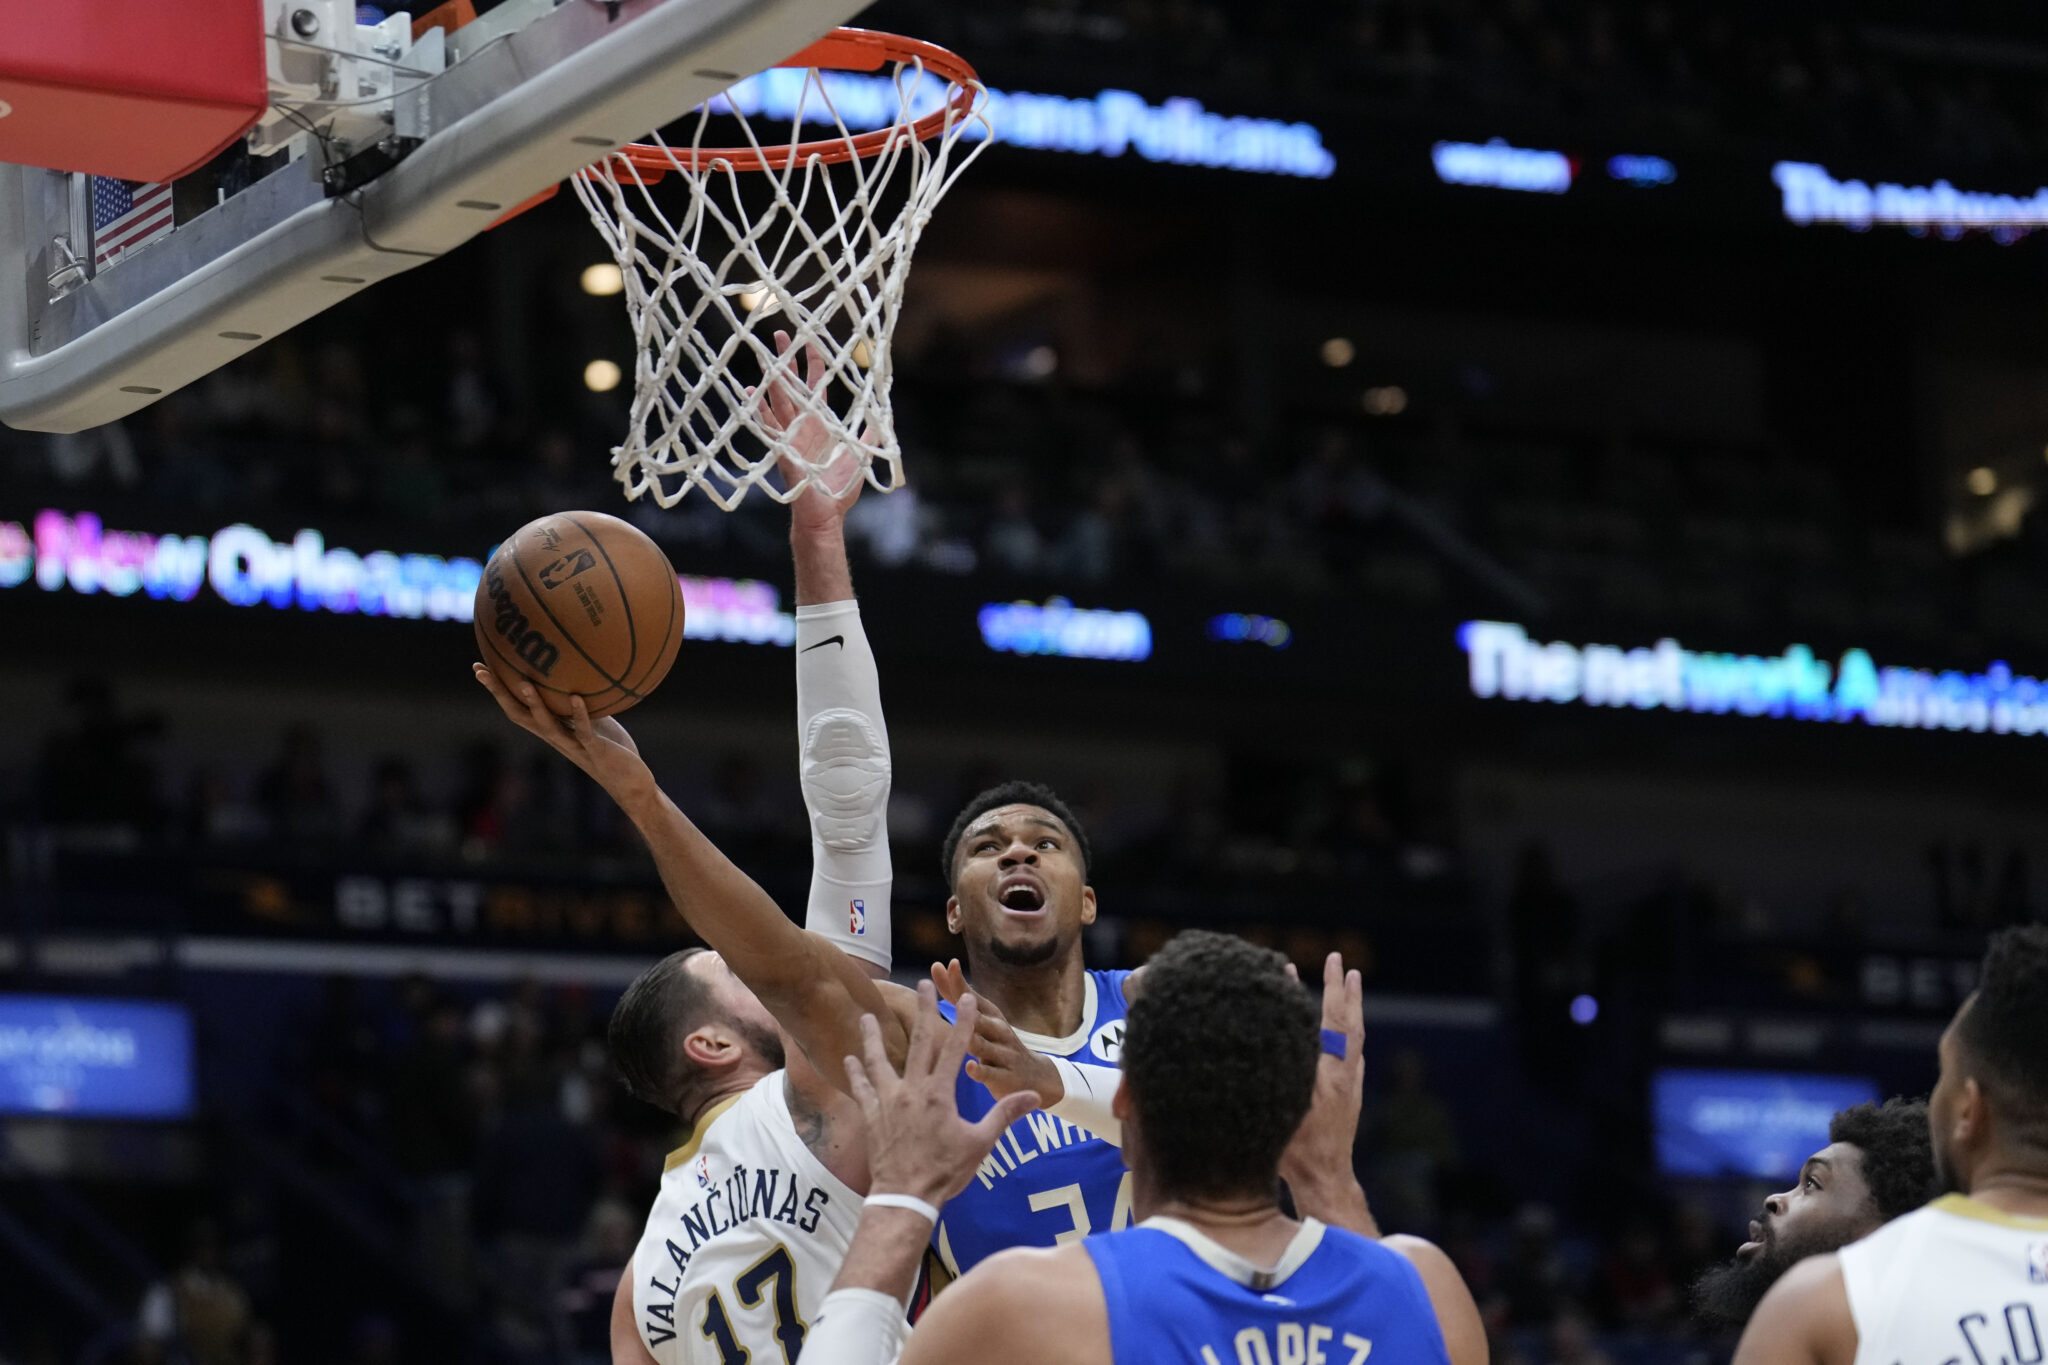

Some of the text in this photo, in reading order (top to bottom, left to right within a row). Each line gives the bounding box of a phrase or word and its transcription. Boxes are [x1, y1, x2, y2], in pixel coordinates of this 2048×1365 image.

[34, 508, 208, 603] New
[209, 522, 488, 624] Orleans
[1456, 620, 2048, 737] The network Americ
[976, 1110, 1102, 1191] MILWA
[646, 1164, 829, 1348] VALANČIŪNAS
[699, 1242, 810, 1365] 17
